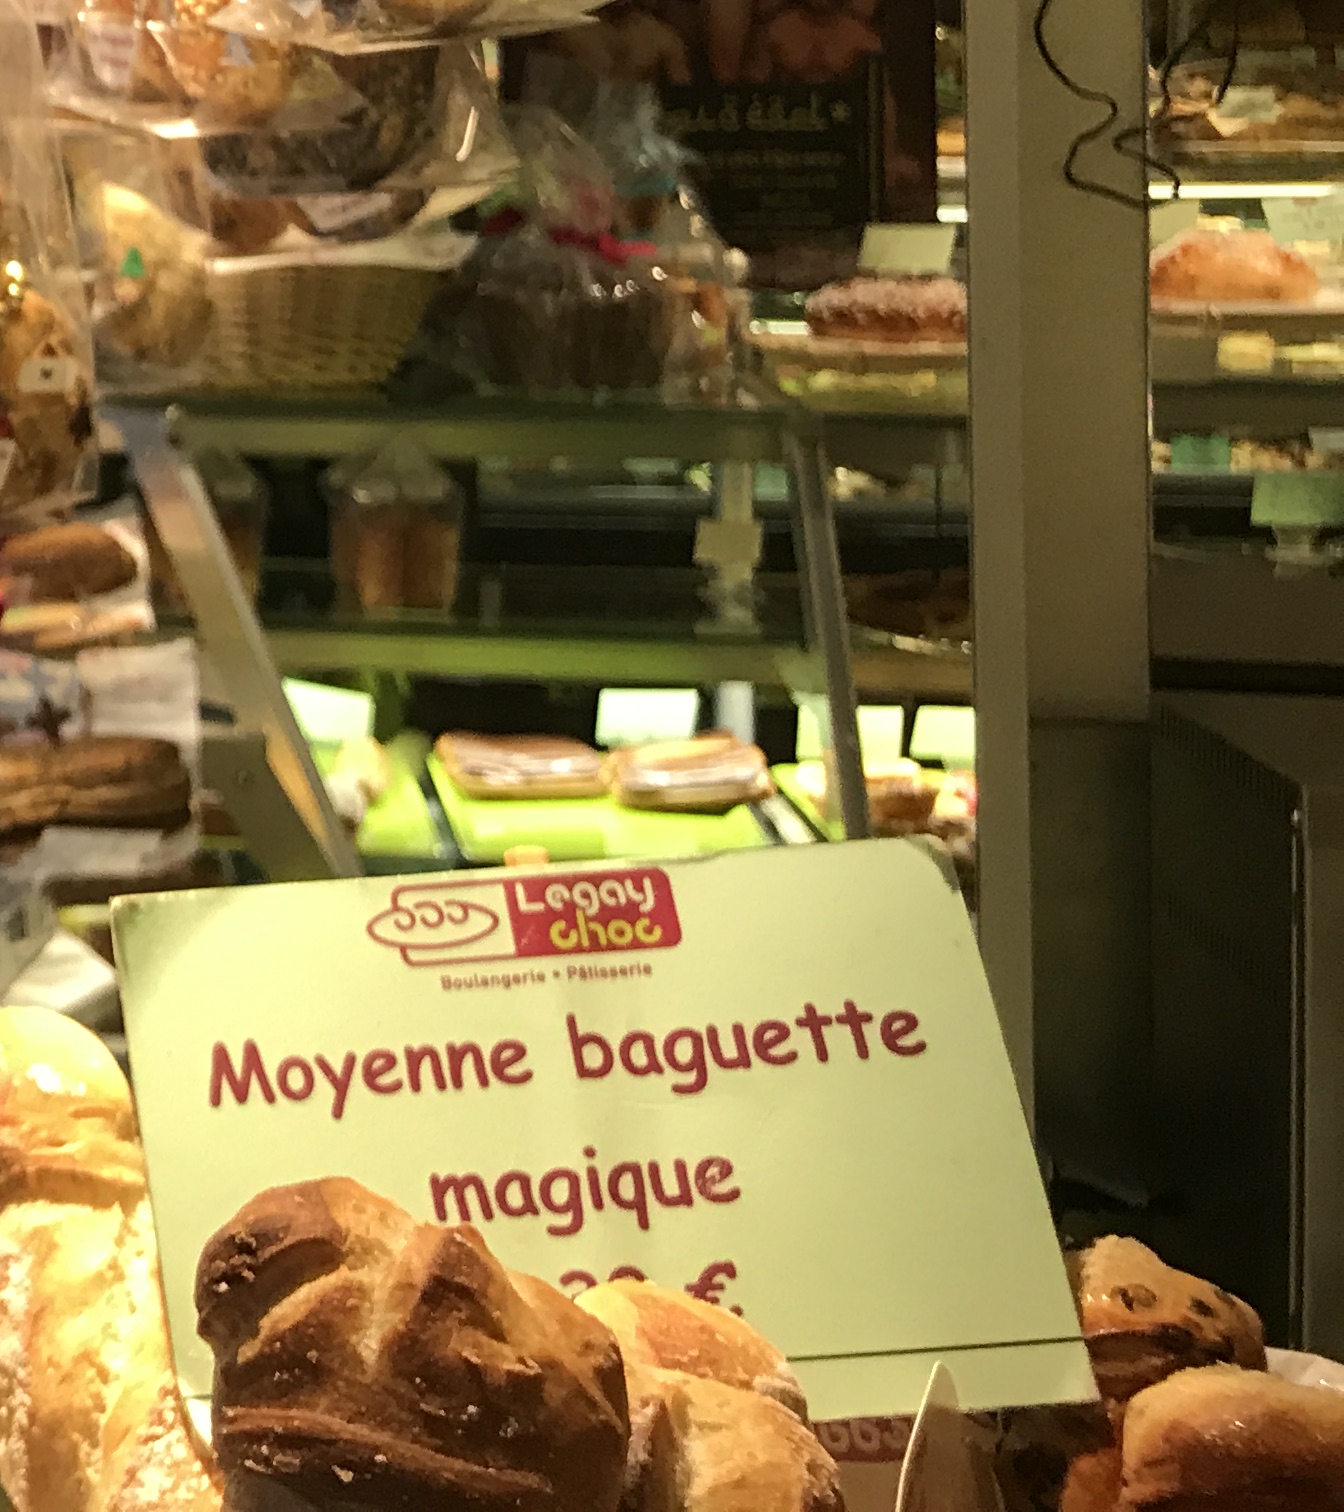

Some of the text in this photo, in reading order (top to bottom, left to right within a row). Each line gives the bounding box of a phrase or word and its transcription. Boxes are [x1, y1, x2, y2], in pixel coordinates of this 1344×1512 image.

[514, 875, 656, 917] Legay
[549, 907, 663, 950] choc
[207, 999, 929, 1120] Moyenne baguette
[429, 1146, 742, 1237] magique
